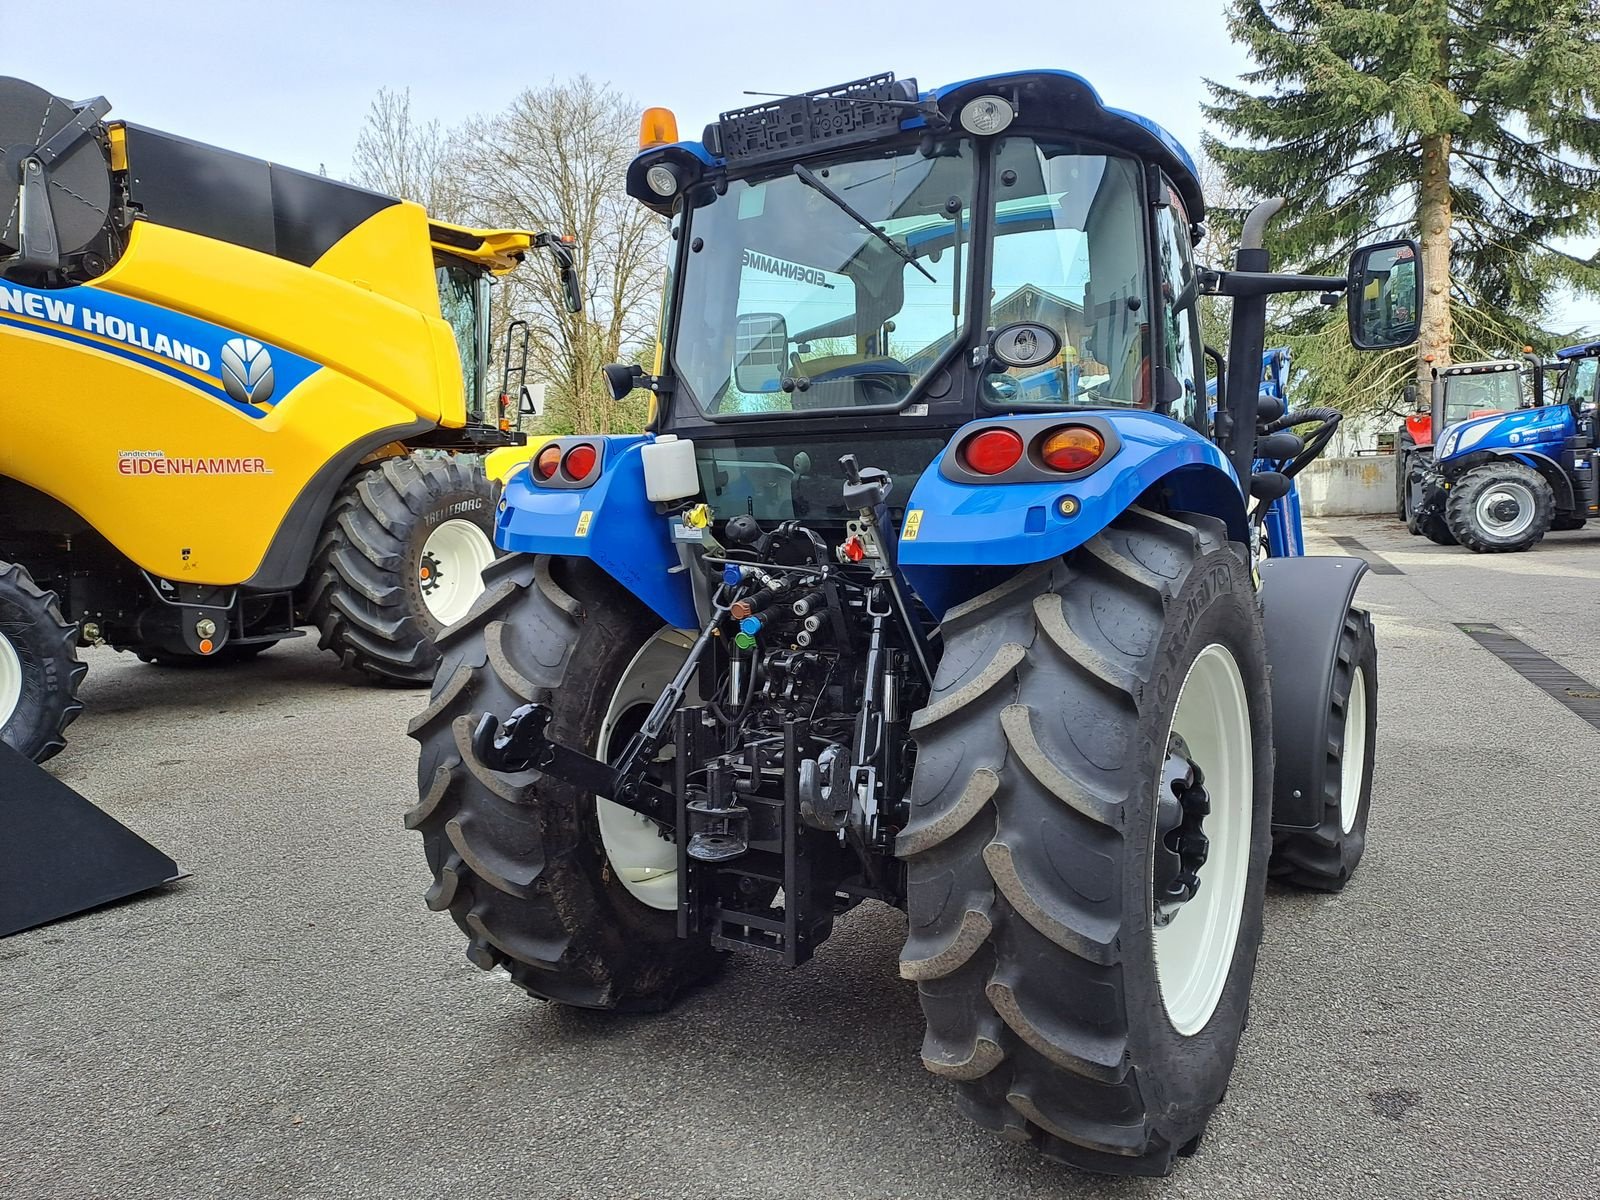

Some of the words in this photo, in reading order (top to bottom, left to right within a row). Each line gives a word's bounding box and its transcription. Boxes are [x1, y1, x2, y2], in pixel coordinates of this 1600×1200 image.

[0, 286, 75, 326] NEW
[82, 307, 211, 372] HOLLAND
[118, 450, 164, 458] Landtechnik
[118, 458, 265, 474] EIDENHAMMER
